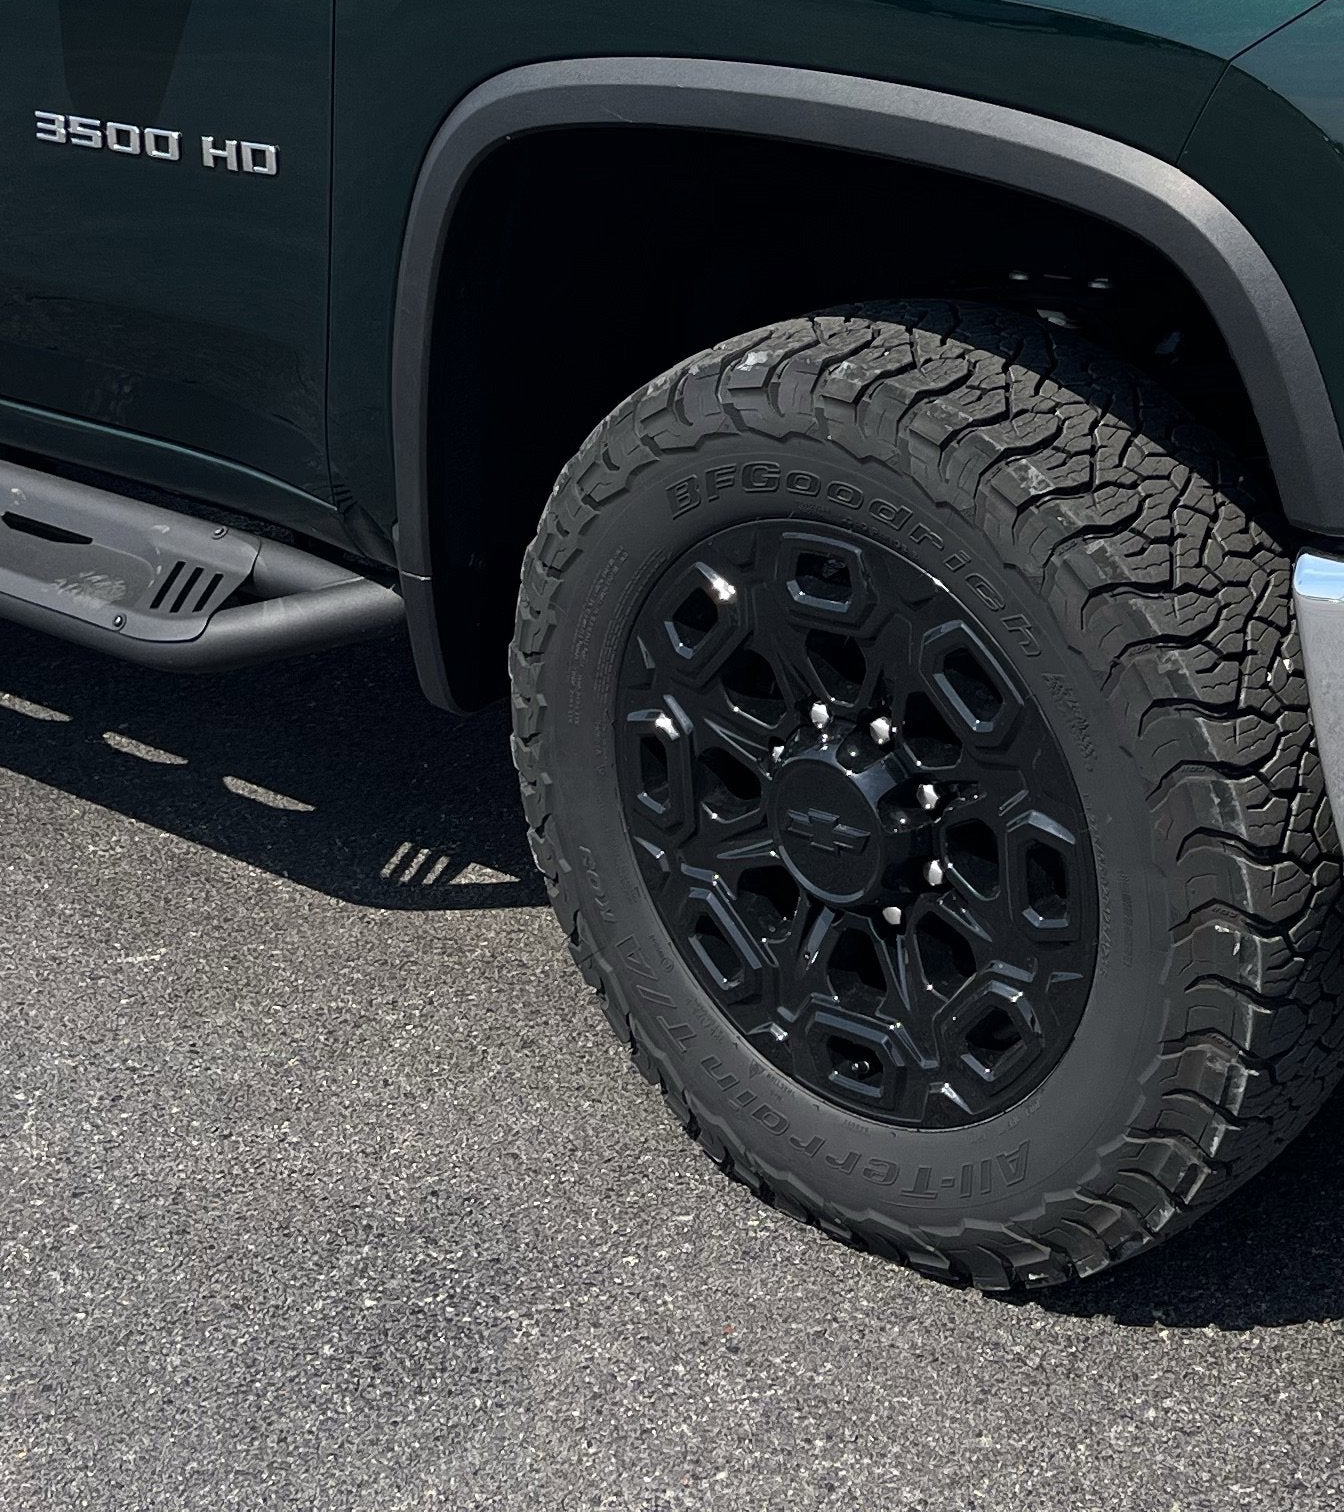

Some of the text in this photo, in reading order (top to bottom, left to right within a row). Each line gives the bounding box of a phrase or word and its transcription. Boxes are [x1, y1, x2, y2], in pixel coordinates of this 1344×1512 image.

[34, 110, 280, 175] 3500 HD
[666, 461, 1041, 657] BFGoodrich
[700, 1055, 1031, 1199] All-Terrain
